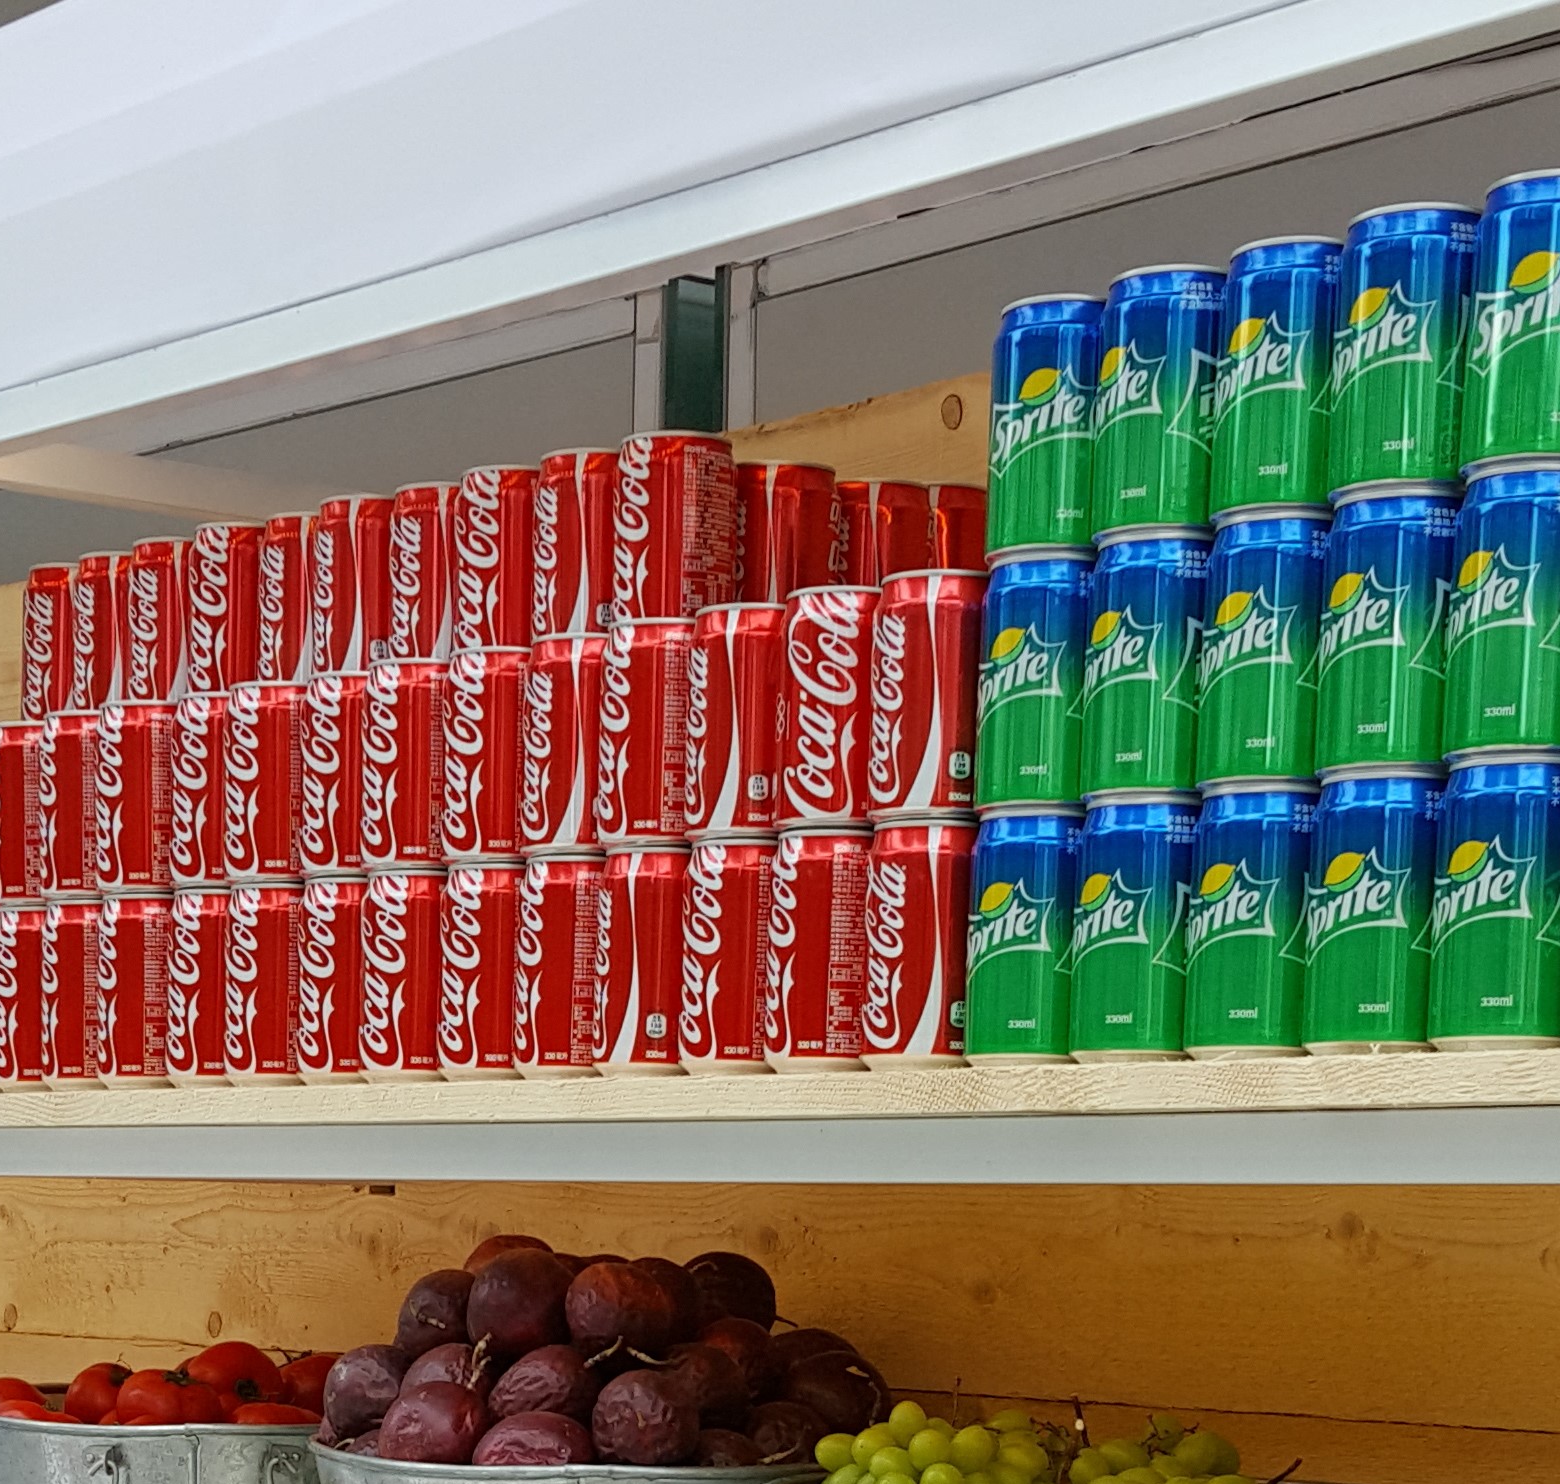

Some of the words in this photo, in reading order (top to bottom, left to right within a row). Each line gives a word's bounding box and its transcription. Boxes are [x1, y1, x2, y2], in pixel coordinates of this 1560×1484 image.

[991, 386, 1086, 465] Sprite
[1094, 363, 1148, 431] prite
[451, 470, 500, 648] oca-Cola
[612, 437, 652, 624] oca-Cola
[189, 526, 229, 694] oca-Cola
[1319, 590, 1389, 668] prite
[1445, 569, 1520, 643] prite
[1085, 627, 1144, 690] prite
[784, 592, 858, 820] Coca-Cola
[1357, 721, 1387, 734] 330ml
[1483, 703, 1515, 718] 330ml
[861, 860, 907, 1049] Coca-Cola
[1073, 894, 1134, 952] prite
[358, 875, 408, 1072] Coca-Cola
[1480, 995, 1513, 1007] 330ml
